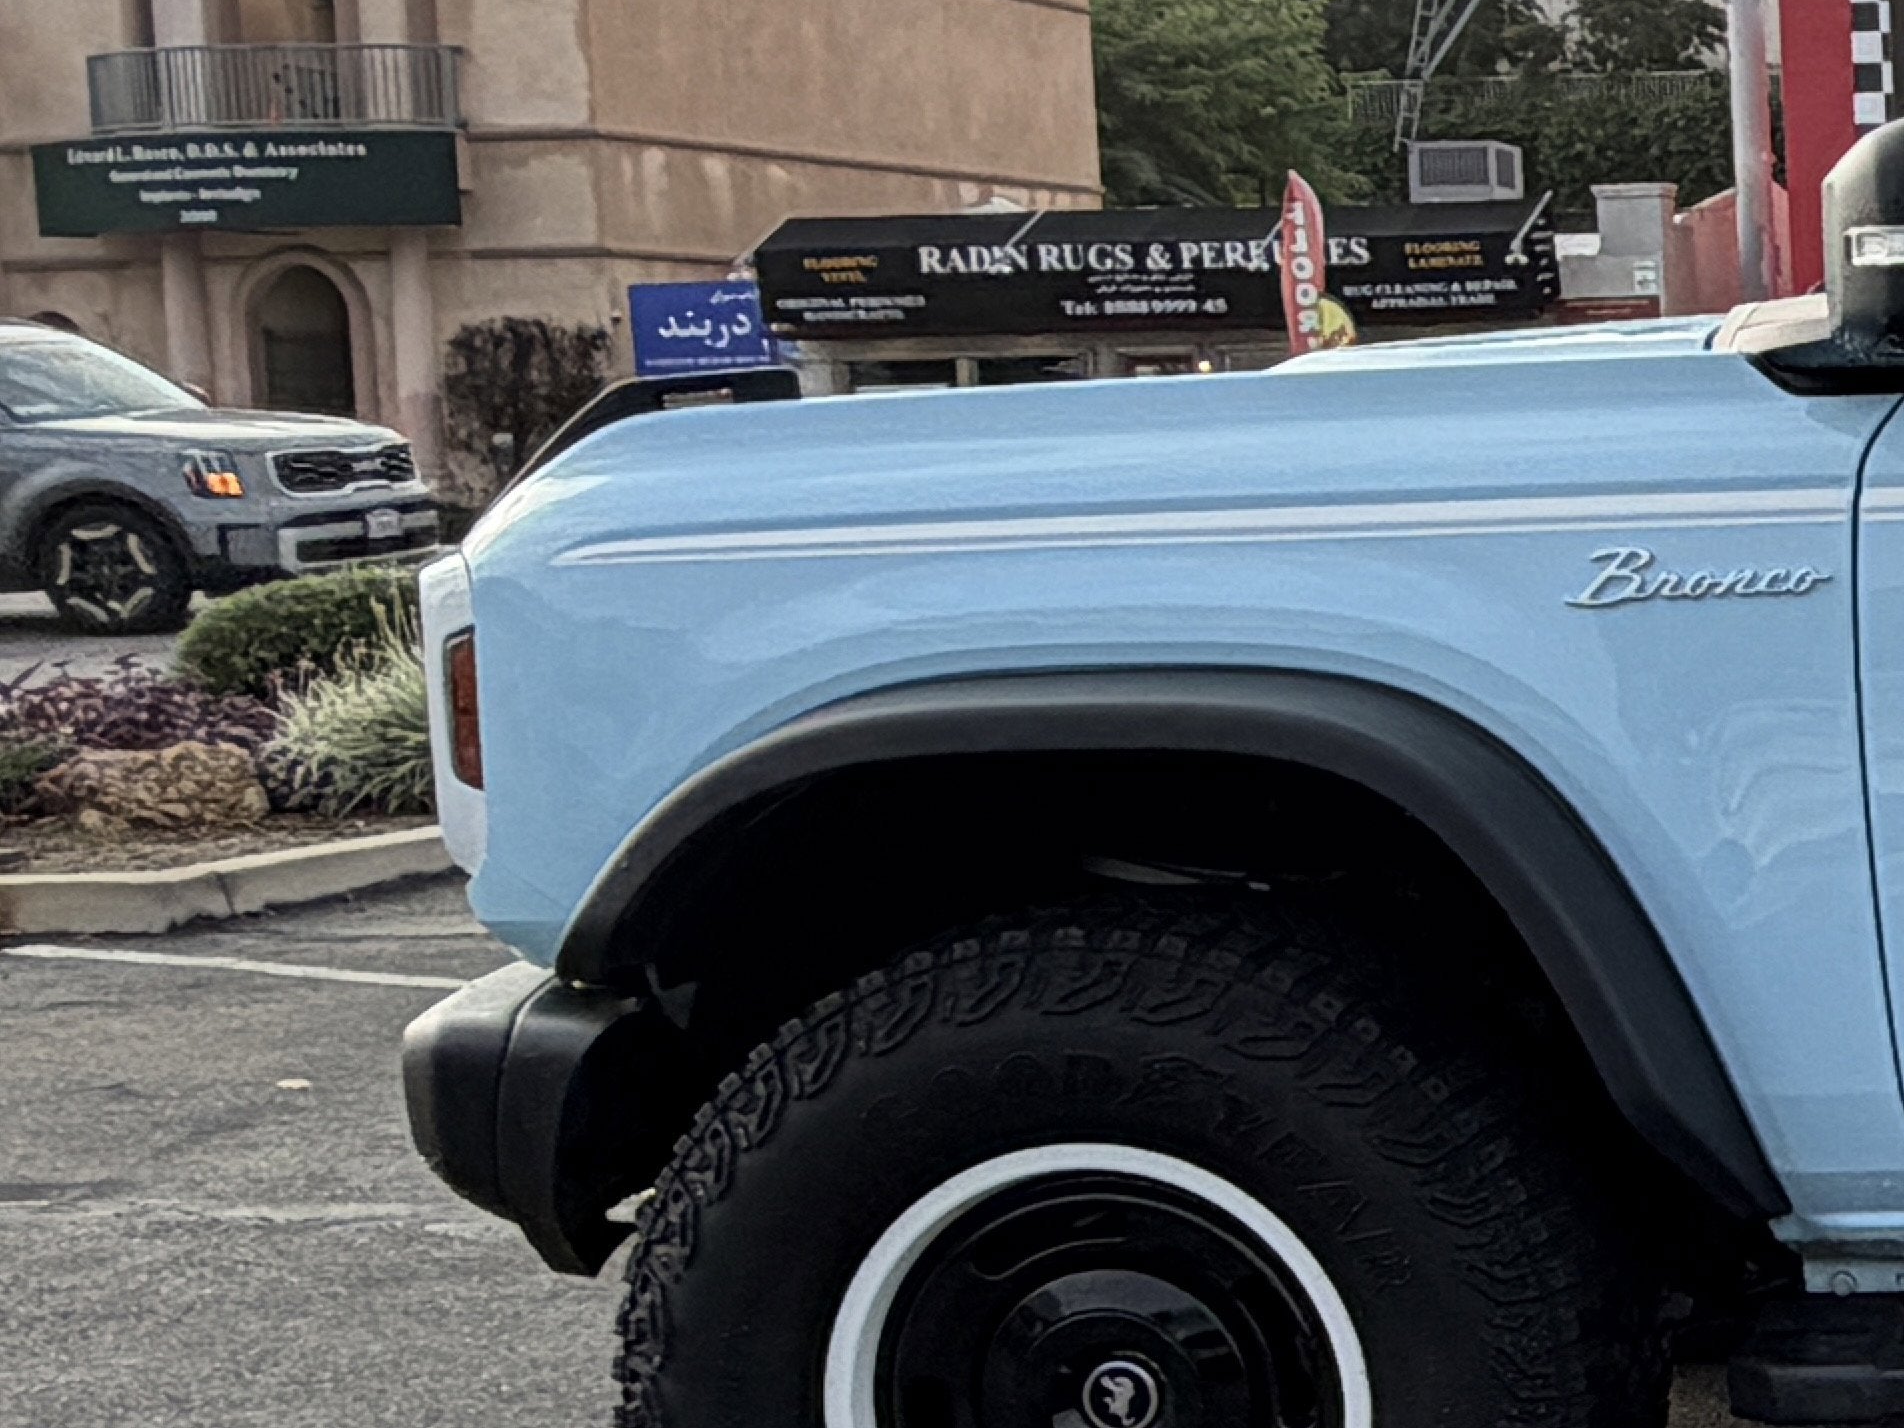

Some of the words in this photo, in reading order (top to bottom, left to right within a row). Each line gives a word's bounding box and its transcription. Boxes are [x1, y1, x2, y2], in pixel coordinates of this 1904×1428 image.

[263, 139, 367, 158] Associates
[1037, 243, 1134, 272] RUGS
[1146, 242, 1173, 271] &
[1179, 237, 1372, 271] PERFUES
[1562, 546, 1835, 608] Bronco
